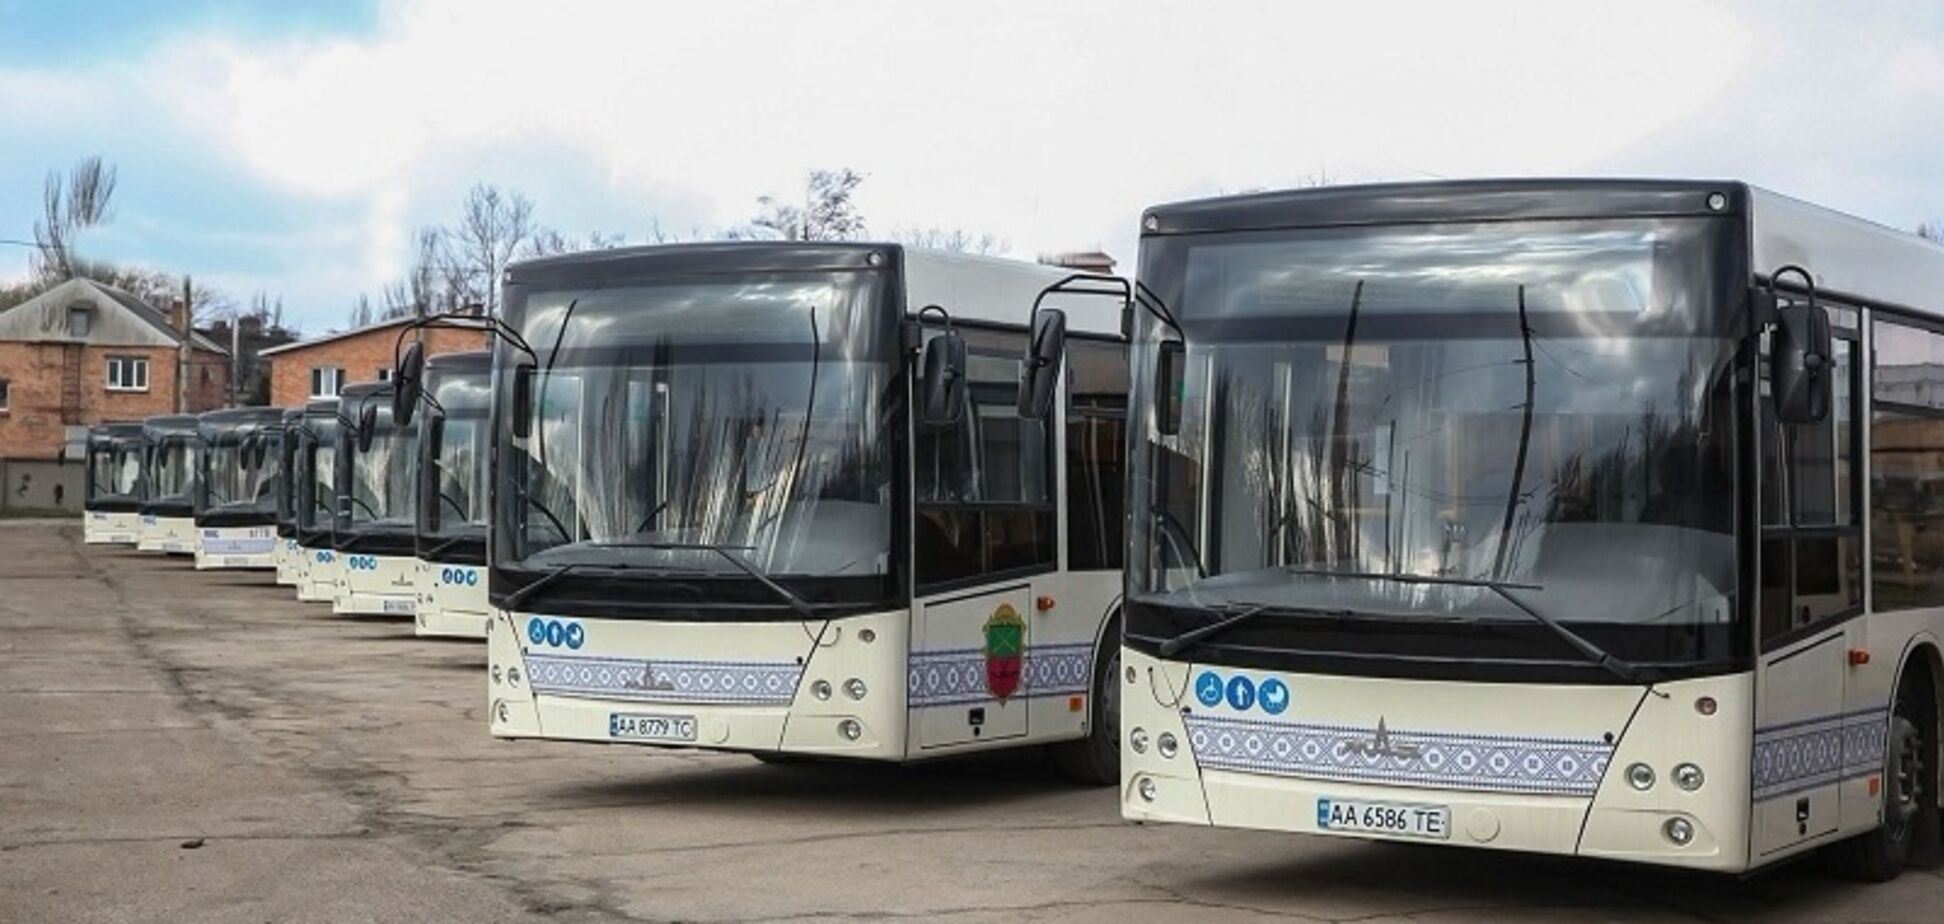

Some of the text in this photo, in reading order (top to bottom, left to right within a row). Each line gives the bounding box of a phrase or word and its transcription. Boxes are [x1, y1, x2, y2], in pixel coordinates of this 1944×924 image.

[618, 718, 694, 738] AA 8779 TC
[1331, 804, 1441, 833] AA 6586 TE
